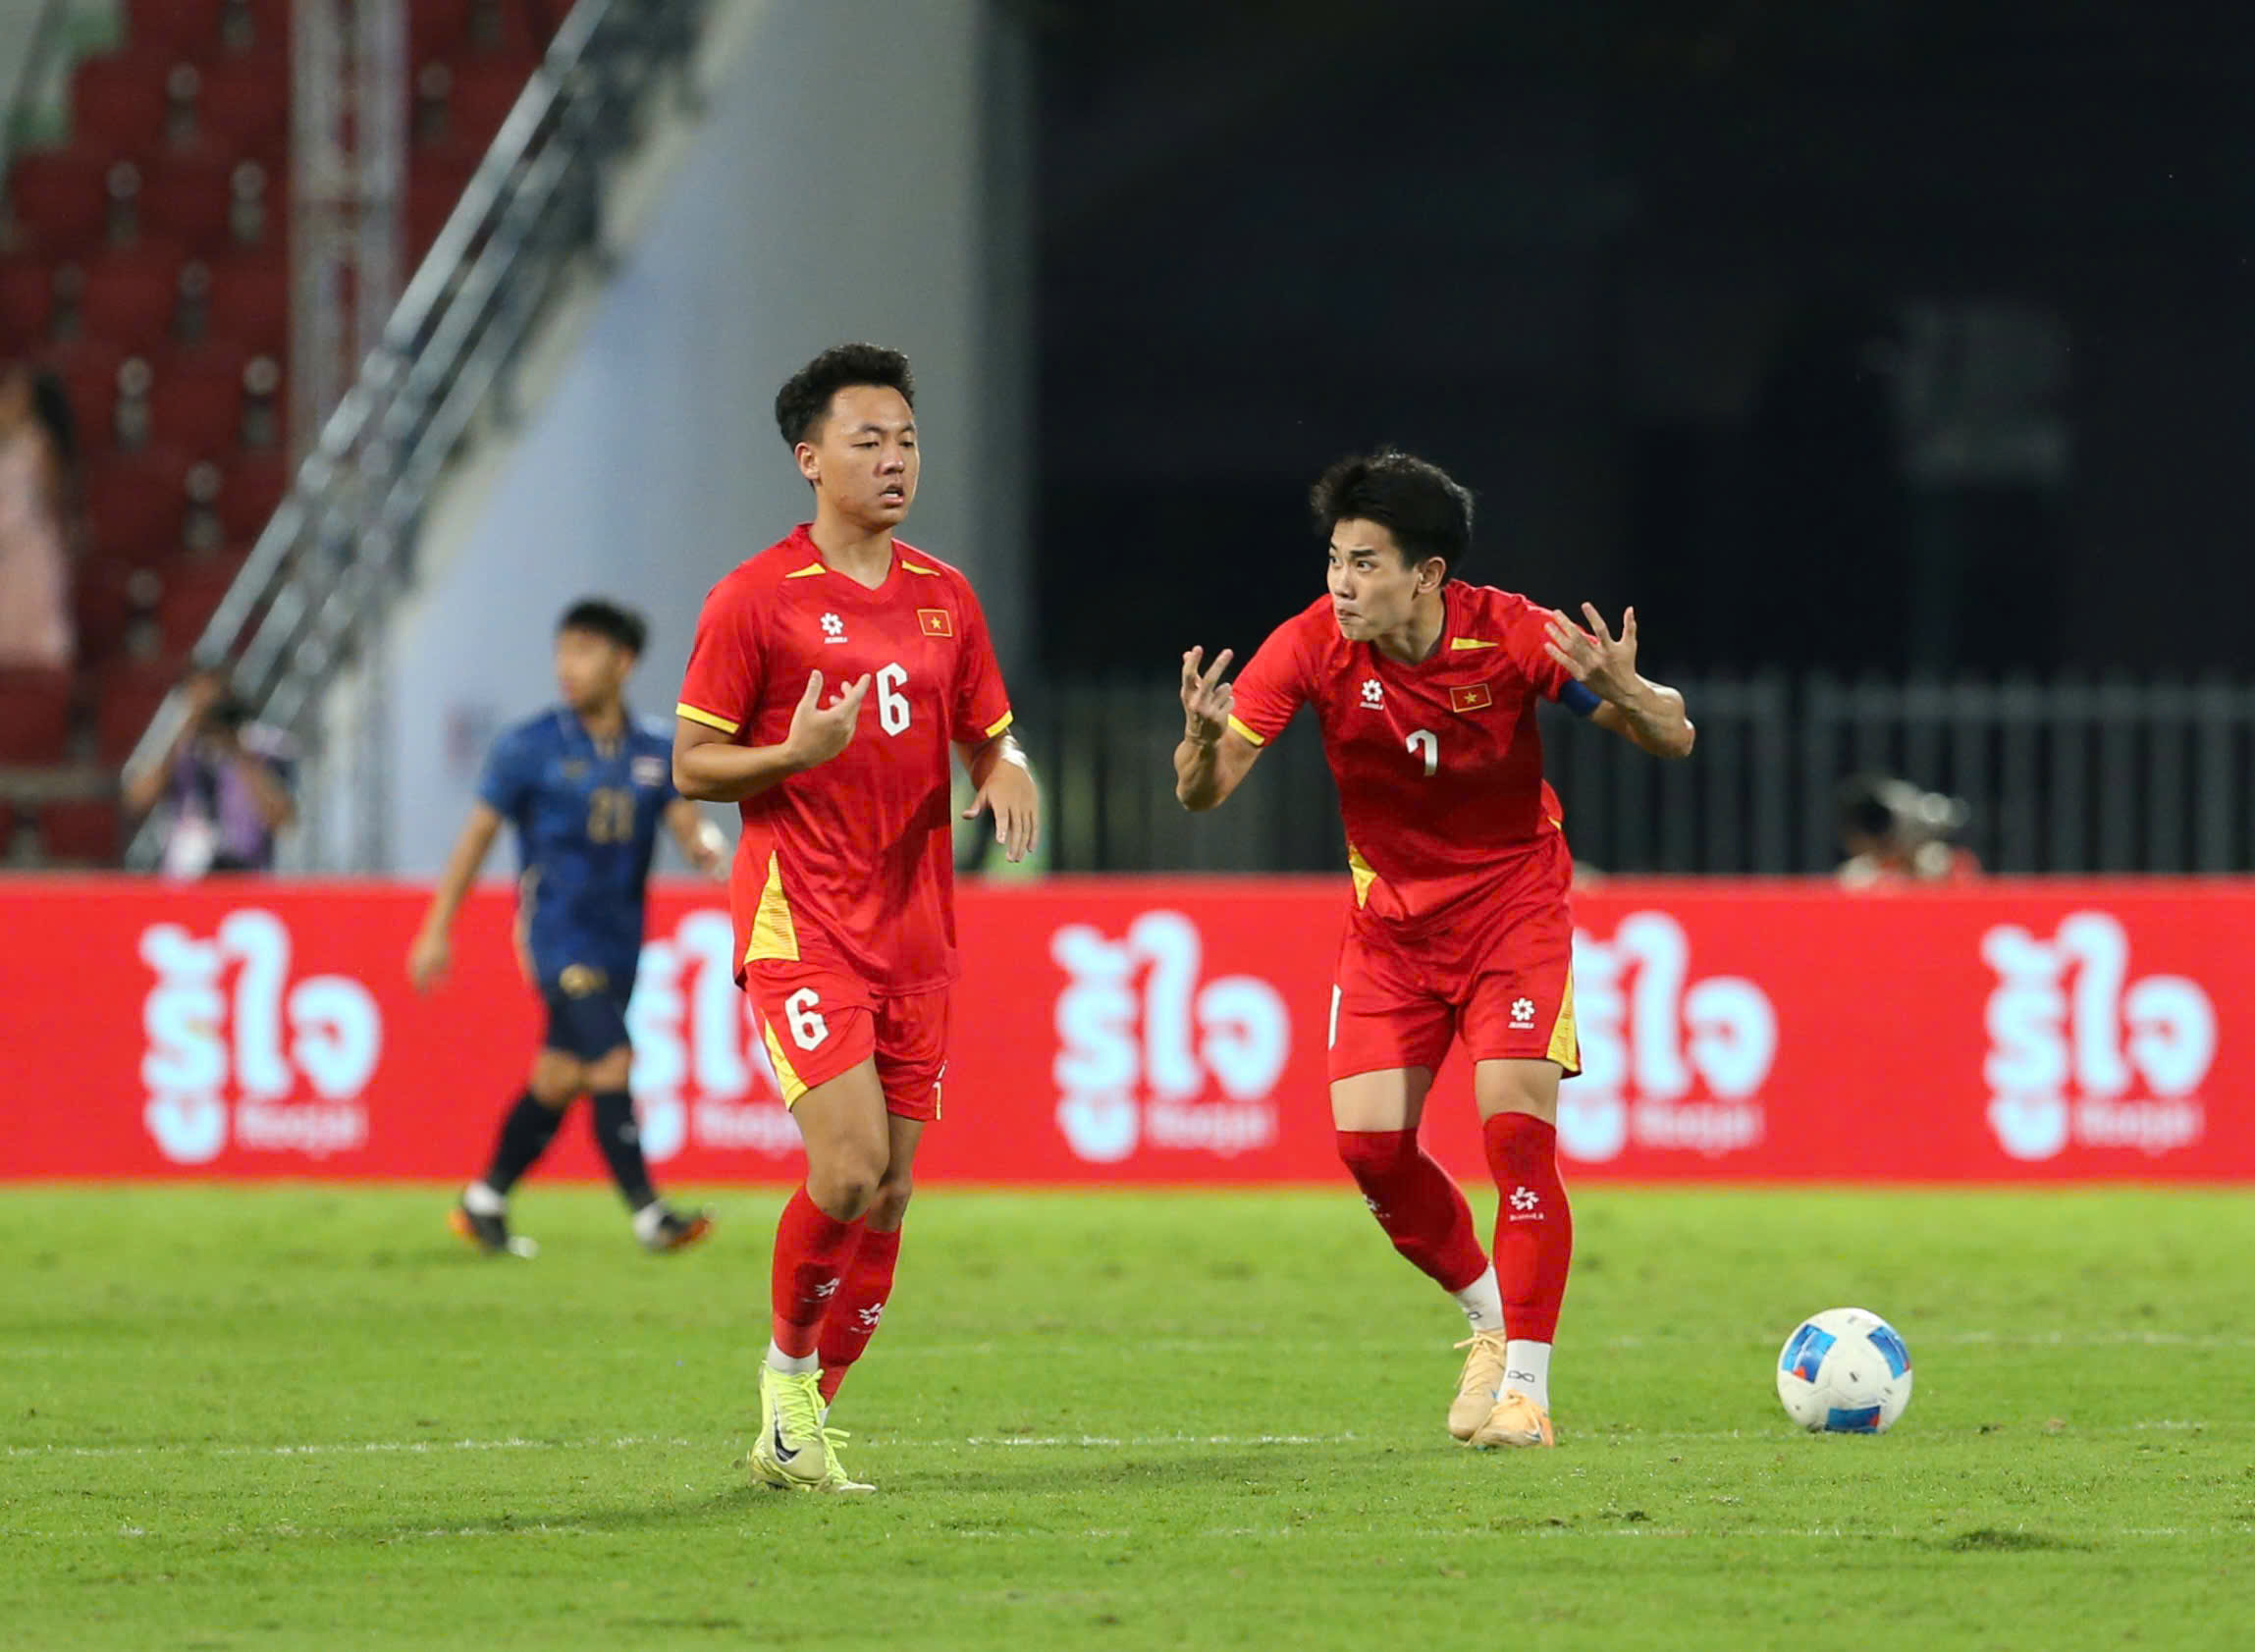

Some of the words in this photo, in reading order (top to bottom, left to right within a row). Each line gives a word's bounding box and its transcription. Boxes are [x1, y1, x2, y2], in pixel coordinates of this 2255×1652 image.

[876, 663, 910, 737] 6
[1406, 729, 1438, 776] 7
[785, 986, 829, 1051] 6
